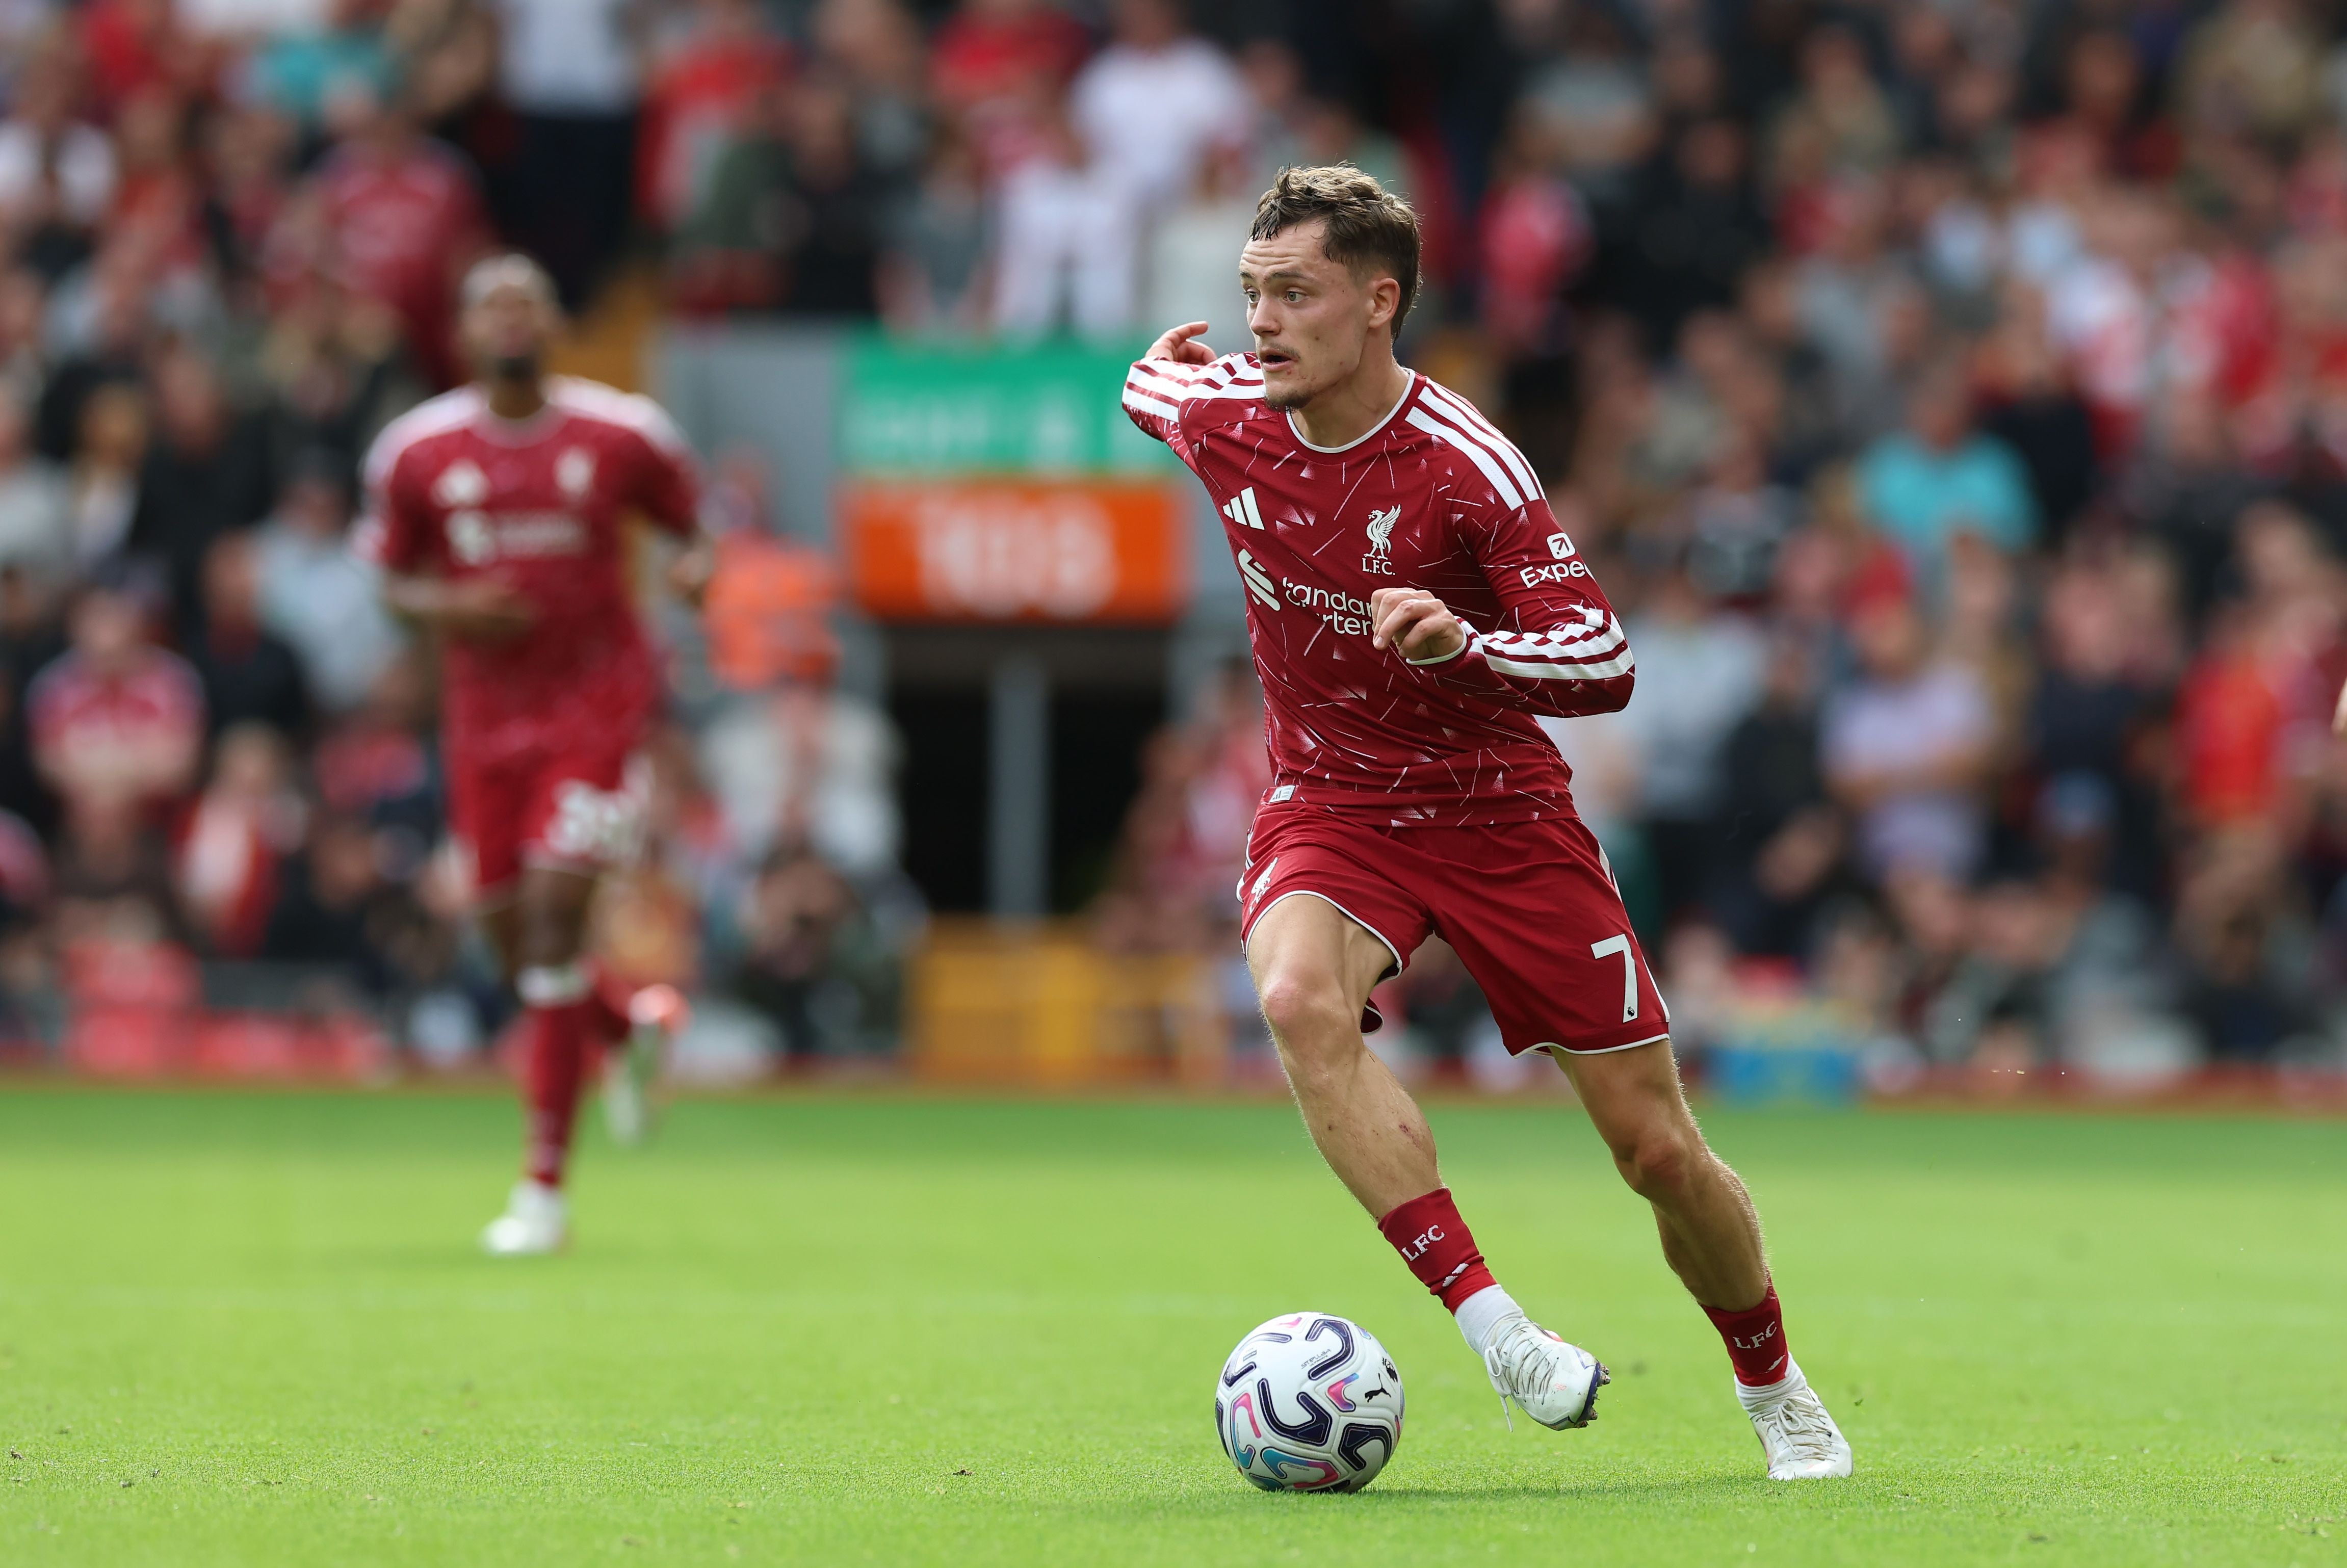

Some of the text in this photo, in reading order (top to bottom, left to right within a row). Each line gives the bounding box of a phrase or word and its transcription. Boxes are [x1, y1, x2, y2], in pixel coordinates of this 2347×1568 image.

[1519, 560, 1593, 589] Expe
[1282, 577, 1372, 617] tandar
[1590, 933, 1638, 1023] 7
[1401, 1224, 1445, 1262] LFC
[1733, 1321, 1777, 1349] LFC
